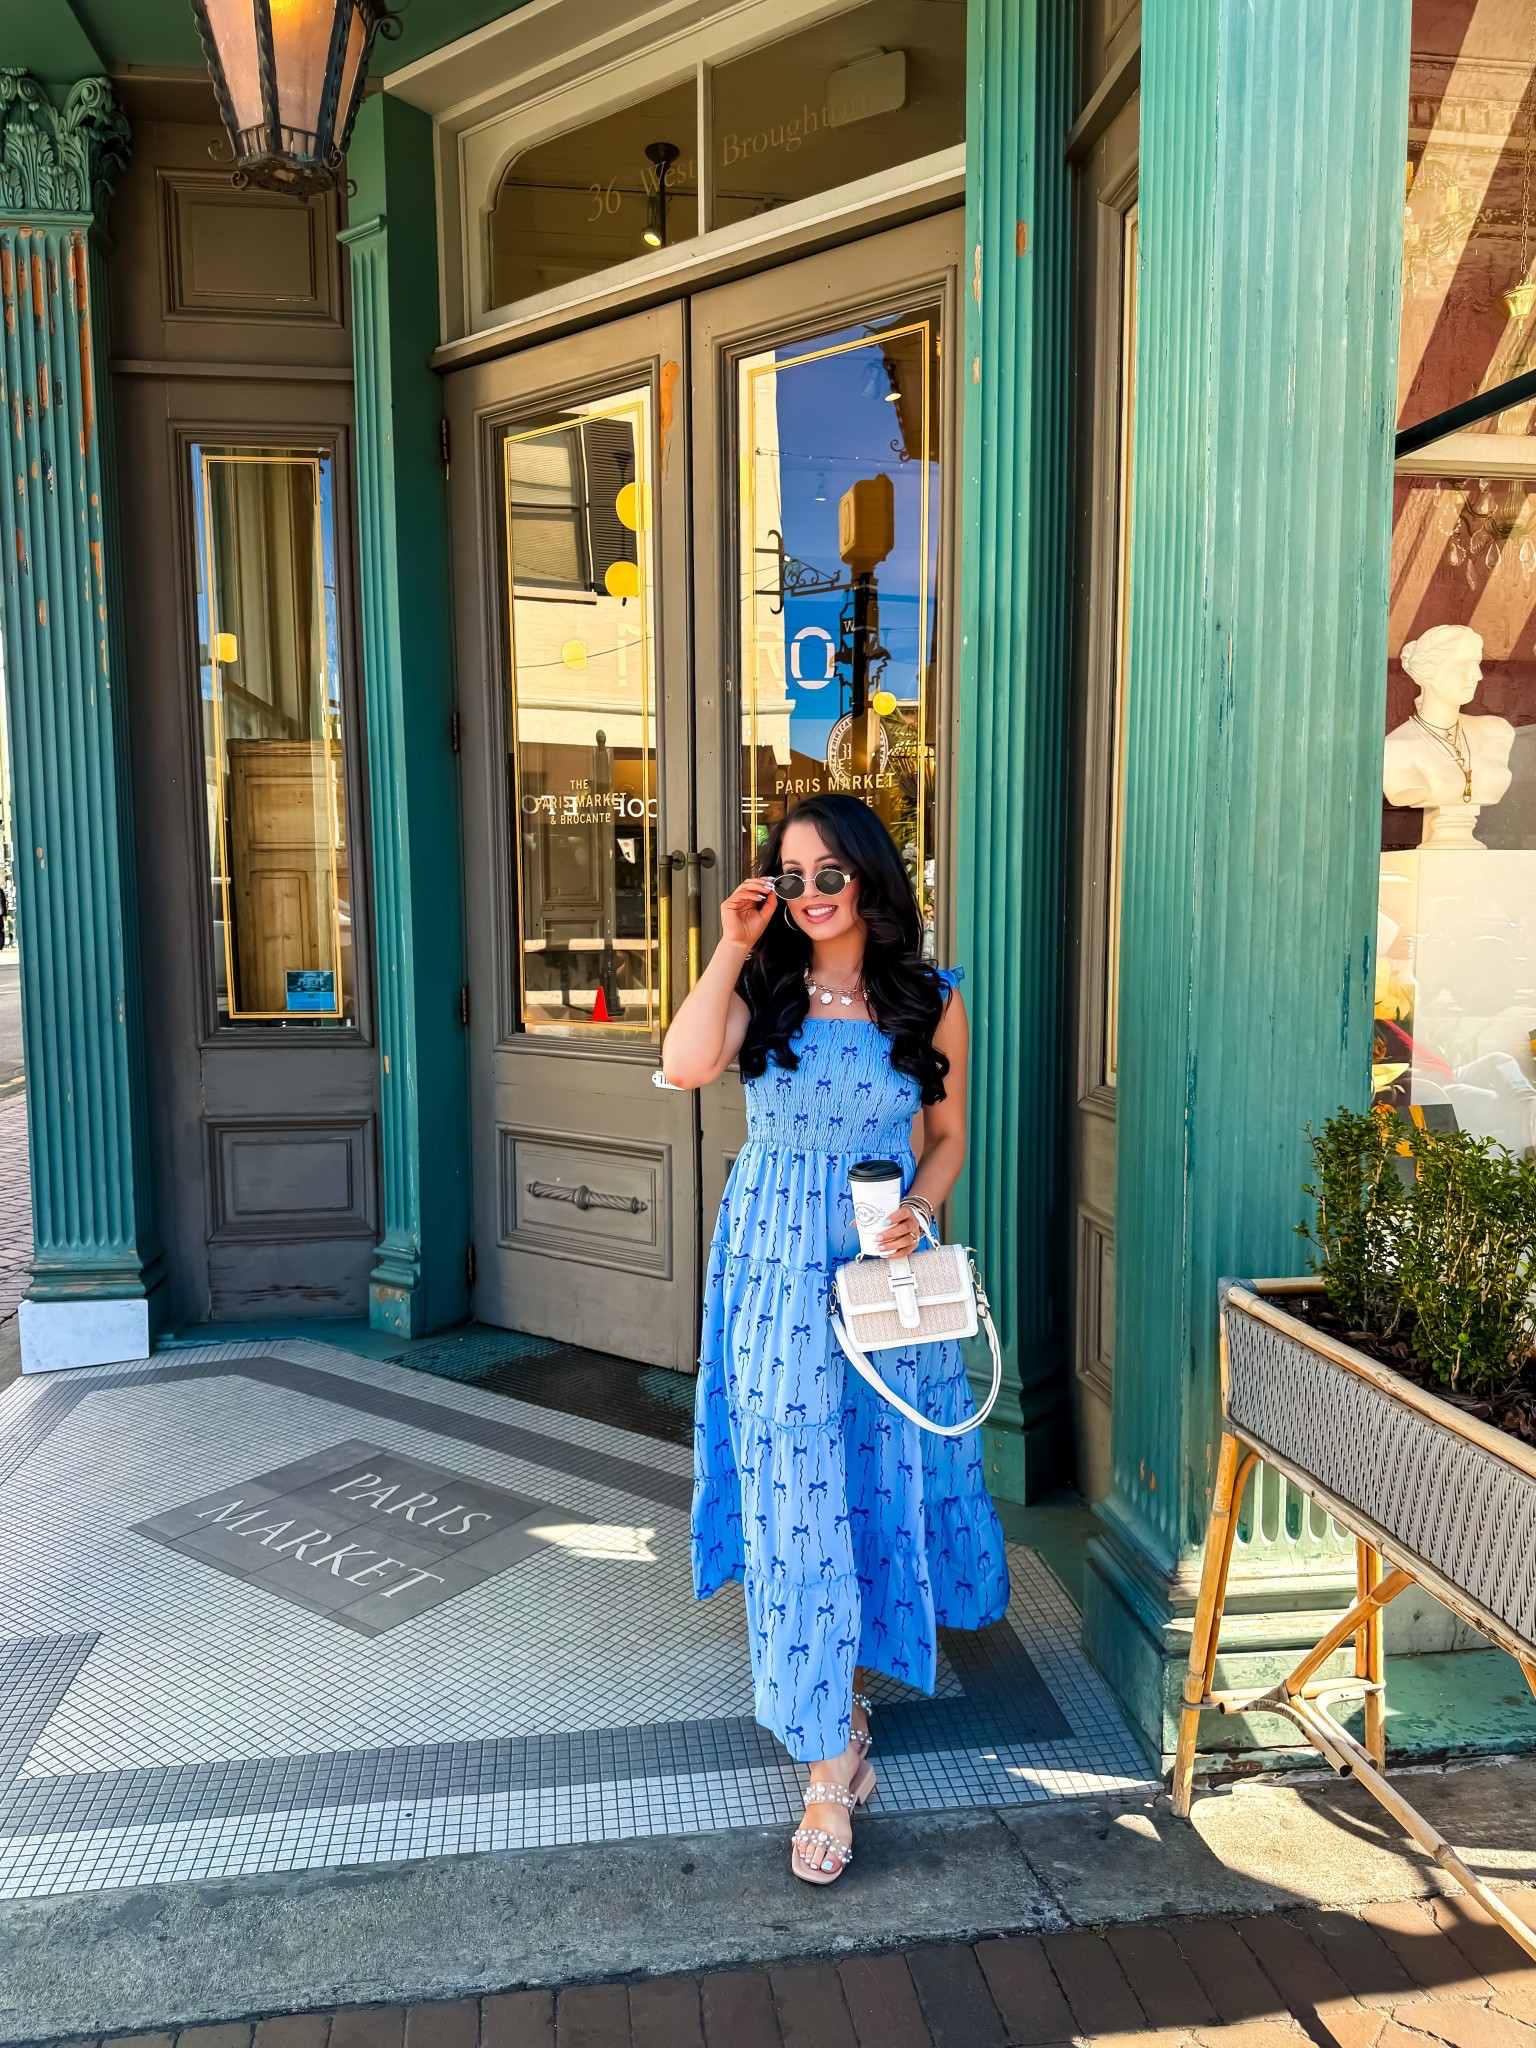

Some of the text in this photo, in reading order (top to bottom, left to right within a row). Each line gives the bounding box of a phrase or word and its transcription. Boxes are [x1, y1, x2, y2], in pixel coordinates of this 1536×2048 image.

[587, 92, 868, 222] 36 West Broughton
[570, 779, 589, 790] THE
[776, 773, 895, 794] PARIS MARKET
[535, 792, 627, 809] PARIS MARKET
[550, 812, 611, 825] & BROCANTE
[329, 1473, 493, 1536] PARIS
[194, 1499, 446, 1599] MARKET
